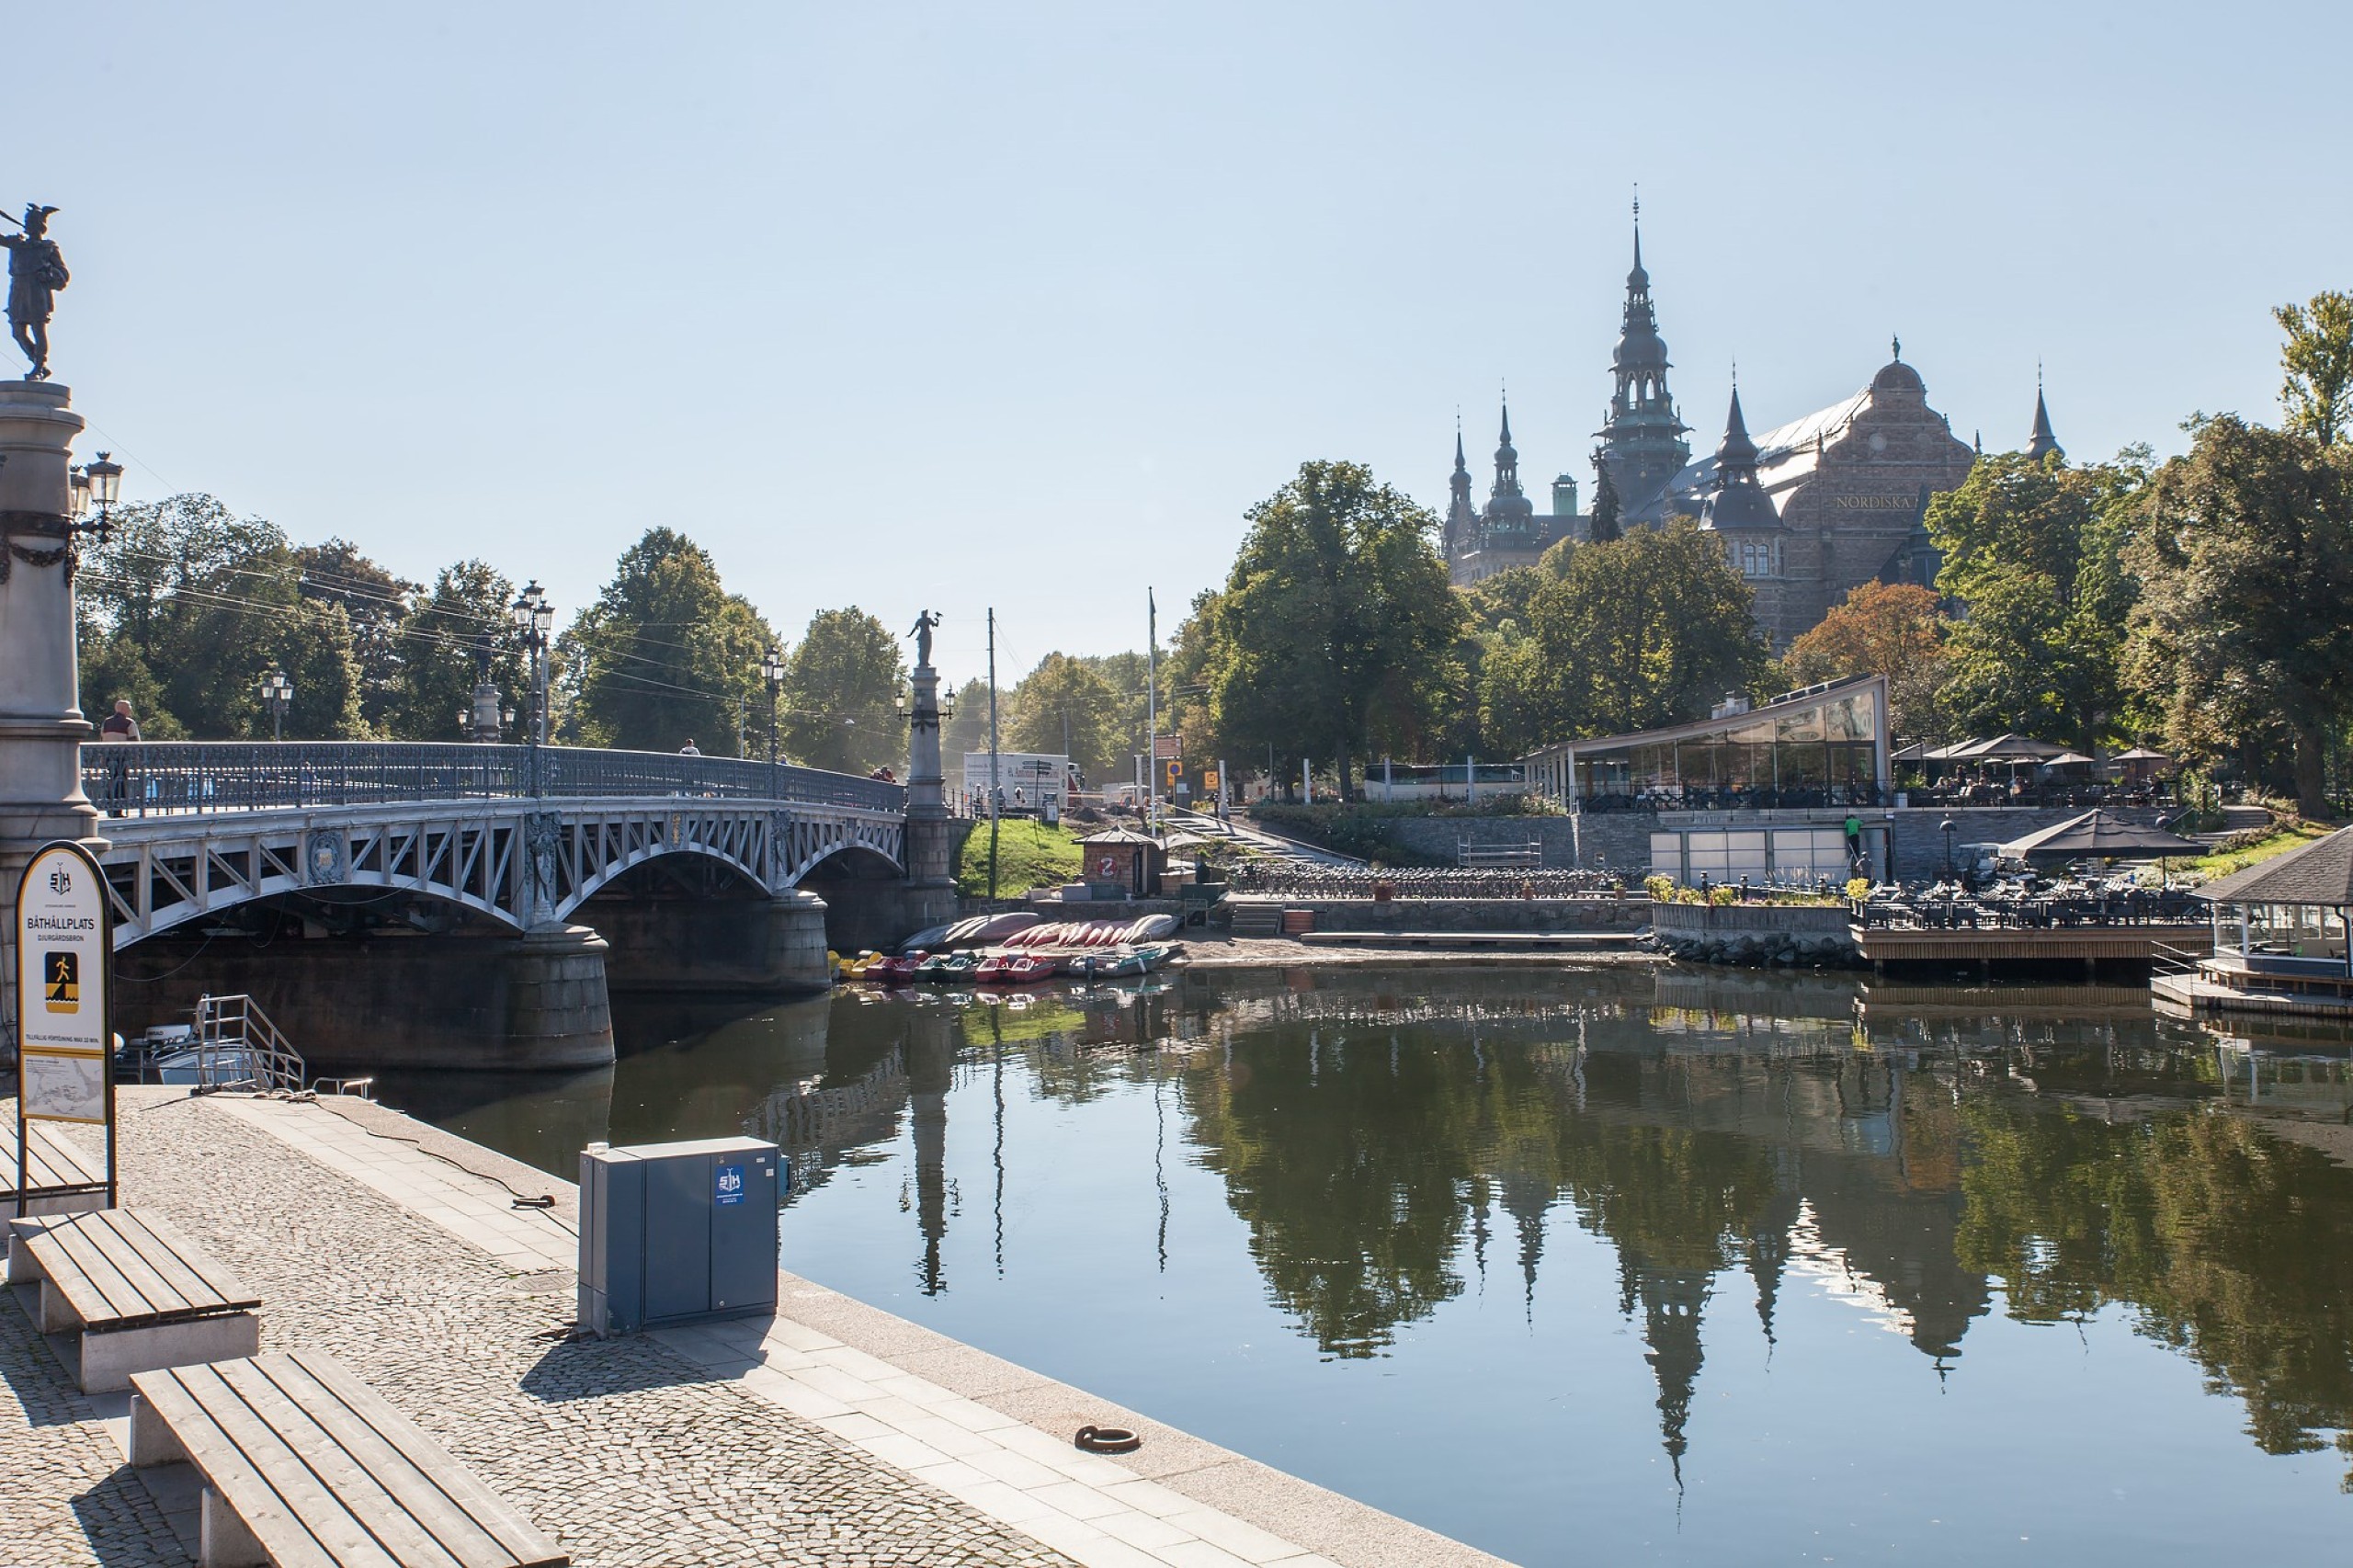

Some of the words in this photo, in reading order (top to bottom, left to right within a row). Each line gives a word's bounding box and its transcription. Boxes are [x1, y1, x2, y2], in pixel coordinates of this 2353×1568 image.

[1837, 496, 1910, 508] NORDISKA
[1101, 858, 1113, 876] 2
[28, 915, 95, 930] BÅTHÅLLPLATS
